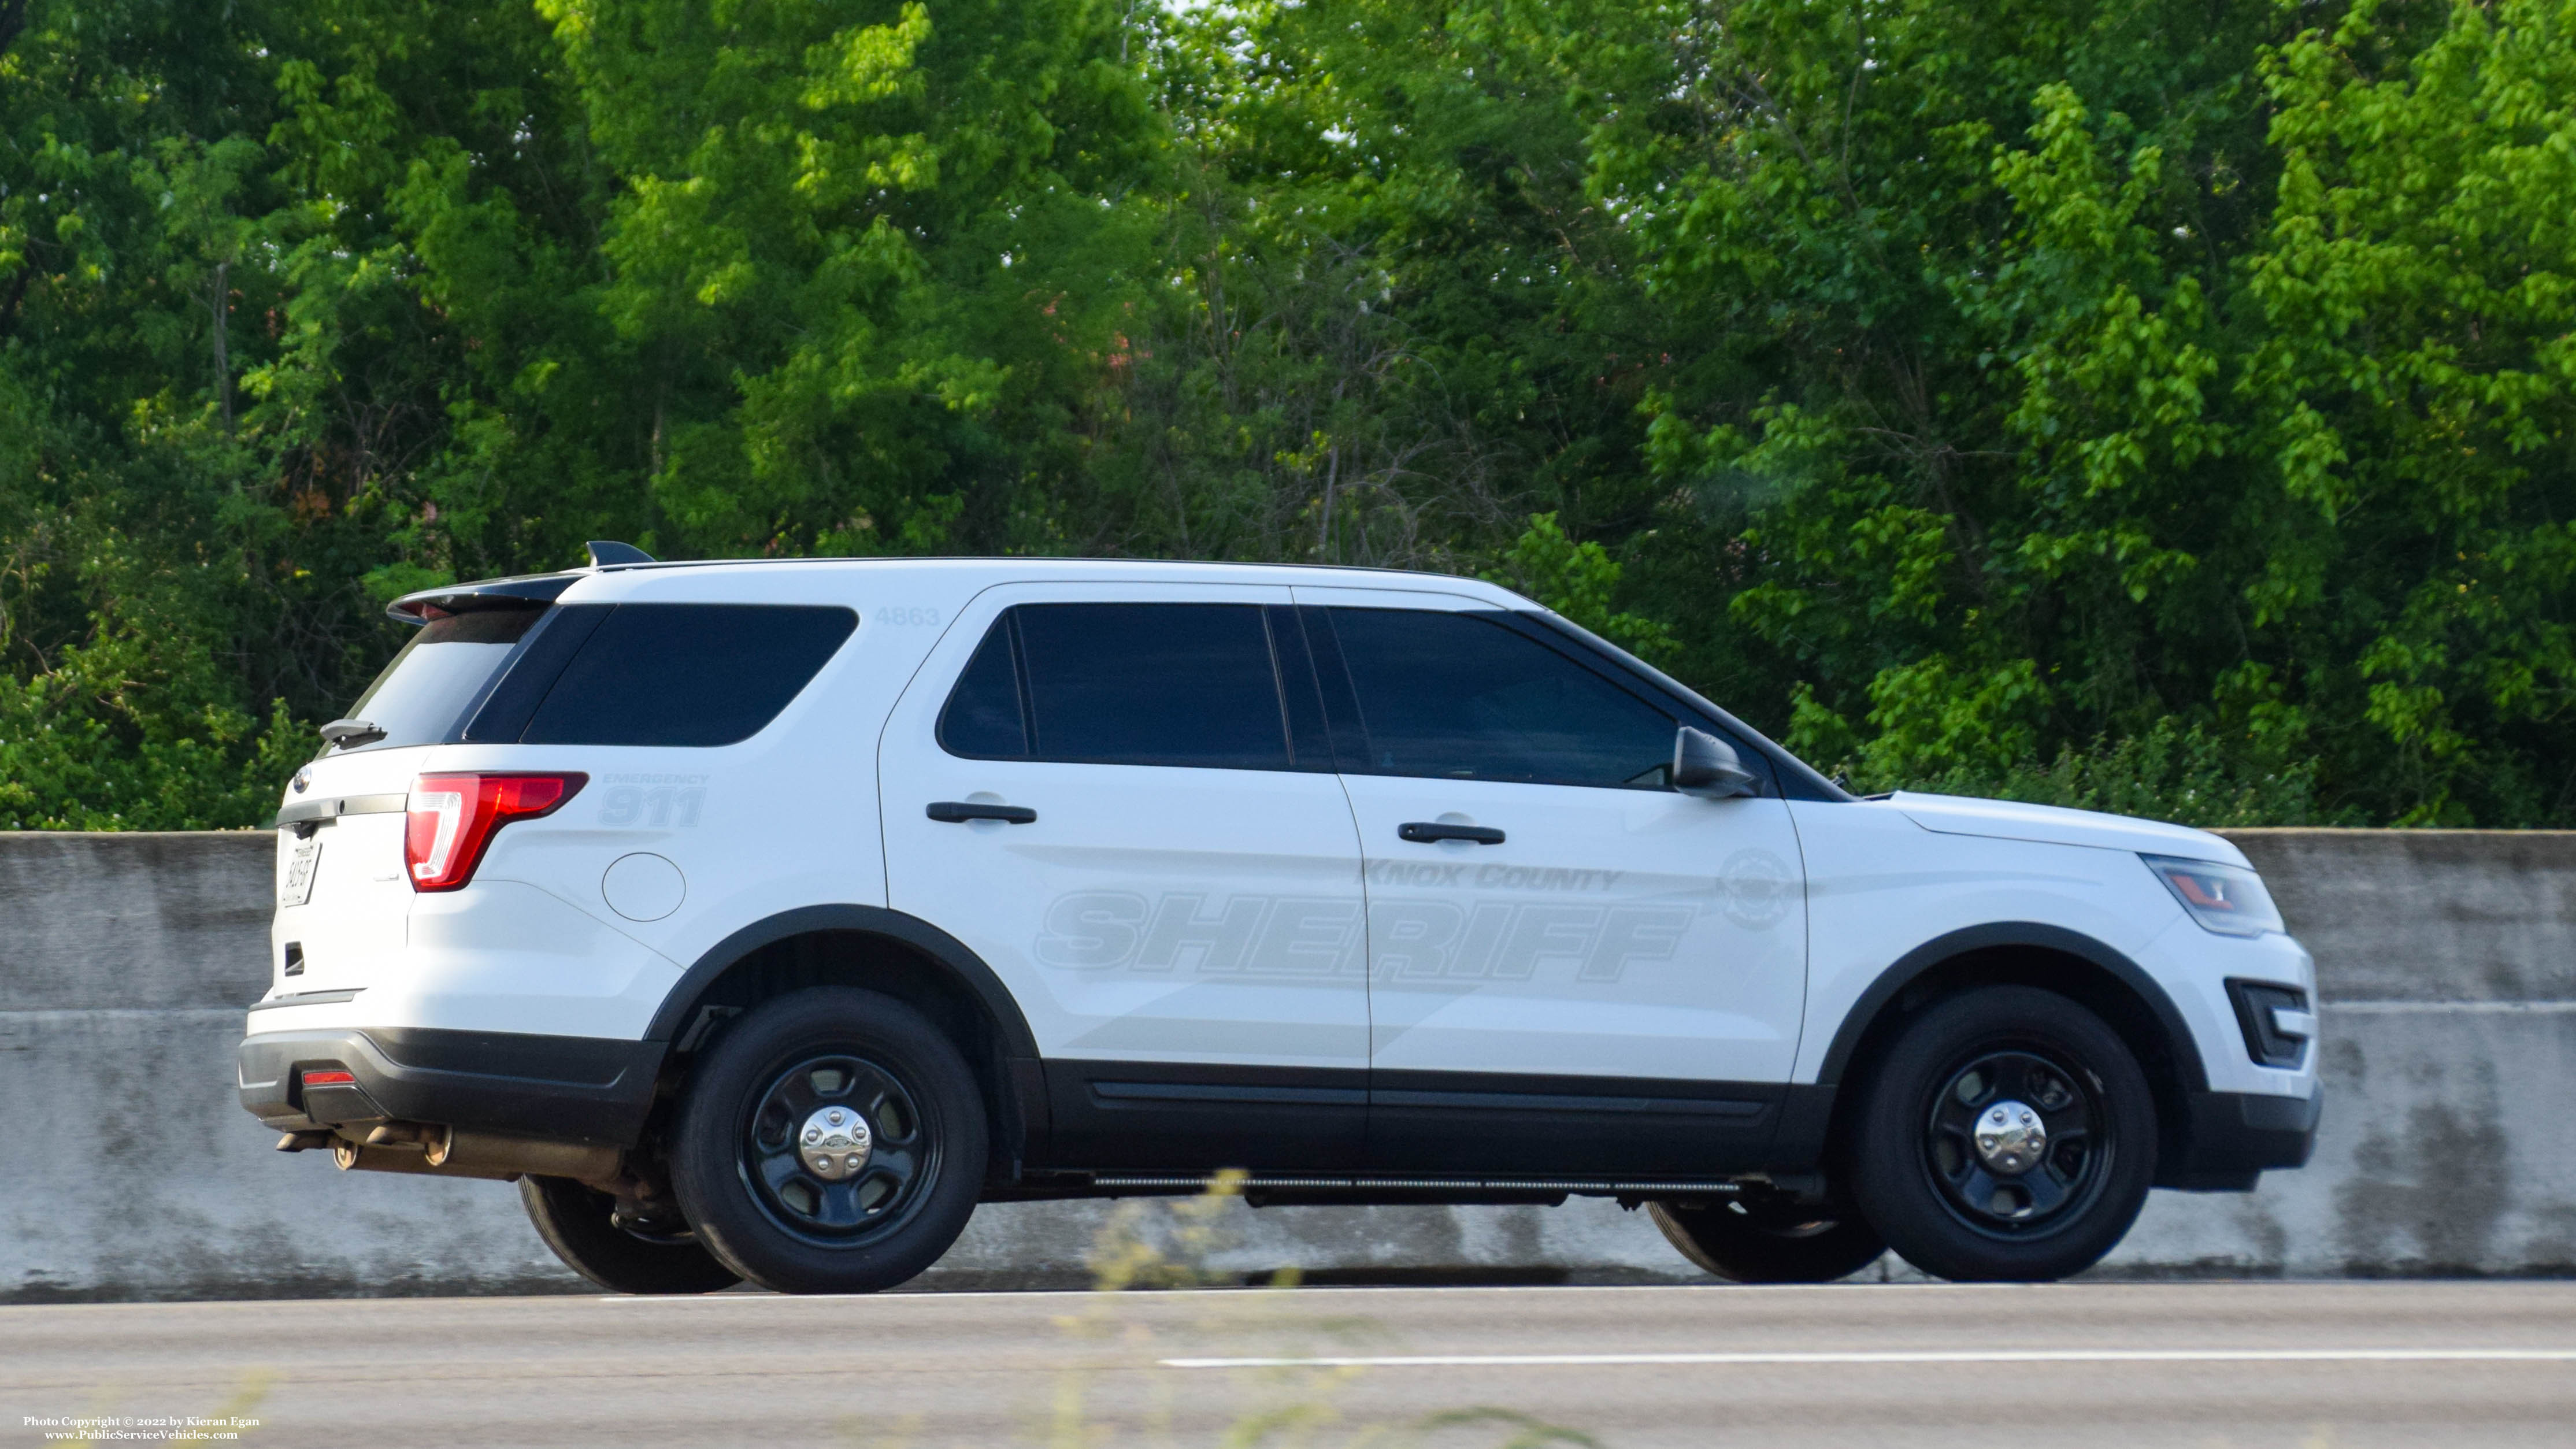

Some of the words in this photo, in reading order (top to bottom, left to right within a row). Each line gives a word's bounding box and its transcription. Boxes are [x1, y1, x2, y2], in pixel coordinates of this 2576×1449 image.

[874, 606, 940, 626] 4863
[602, 773, 710, 784] EMERGENCY
[598, 785, 708, 828] 911
[1354, 859, 1467, 887] KNOX
[1473, 862, 1626, 892] COUNTY
[1034, 888, 1704, 983] SHERIFF
